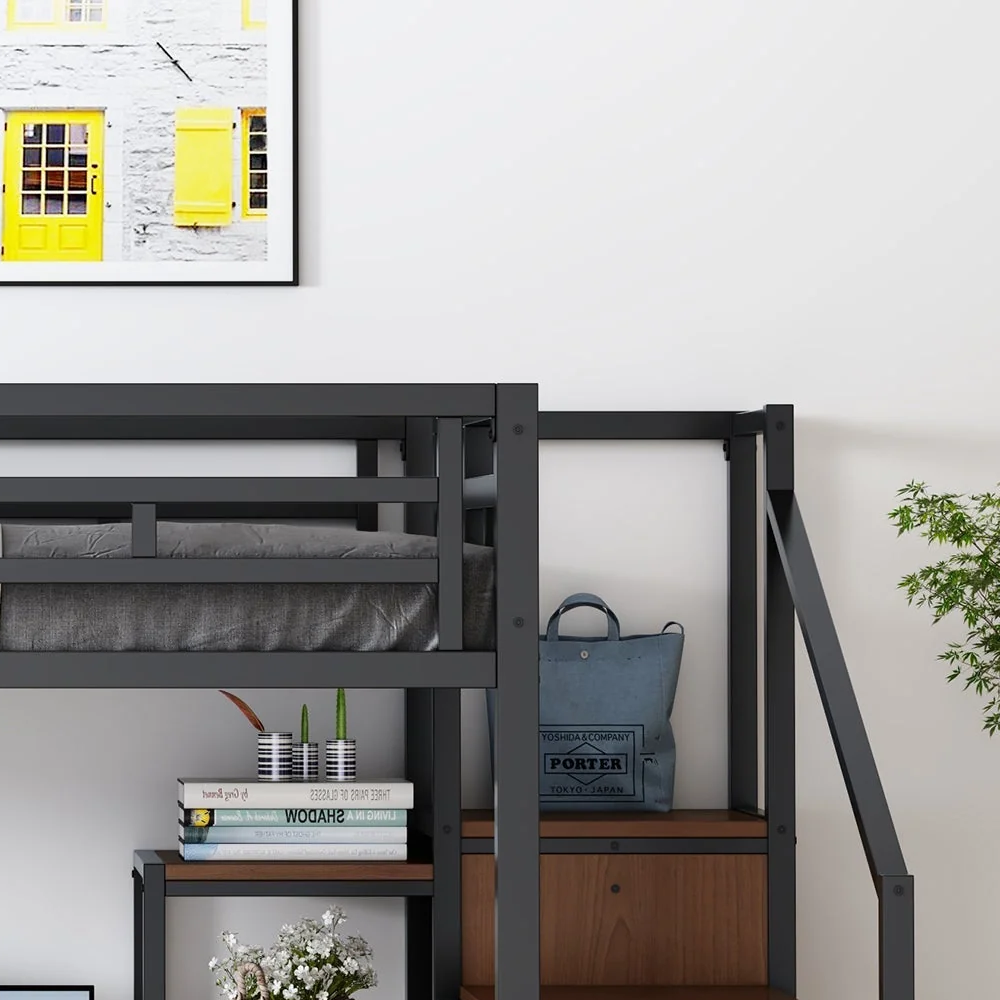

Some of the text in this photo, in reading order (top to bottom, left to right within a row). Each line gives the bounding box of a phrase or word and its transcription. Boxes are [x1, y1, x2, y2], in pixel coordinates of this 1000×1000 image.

[550, 758, 622, 770] PORTER
[550, 786, 624, 794] TOKYO JAPAN
